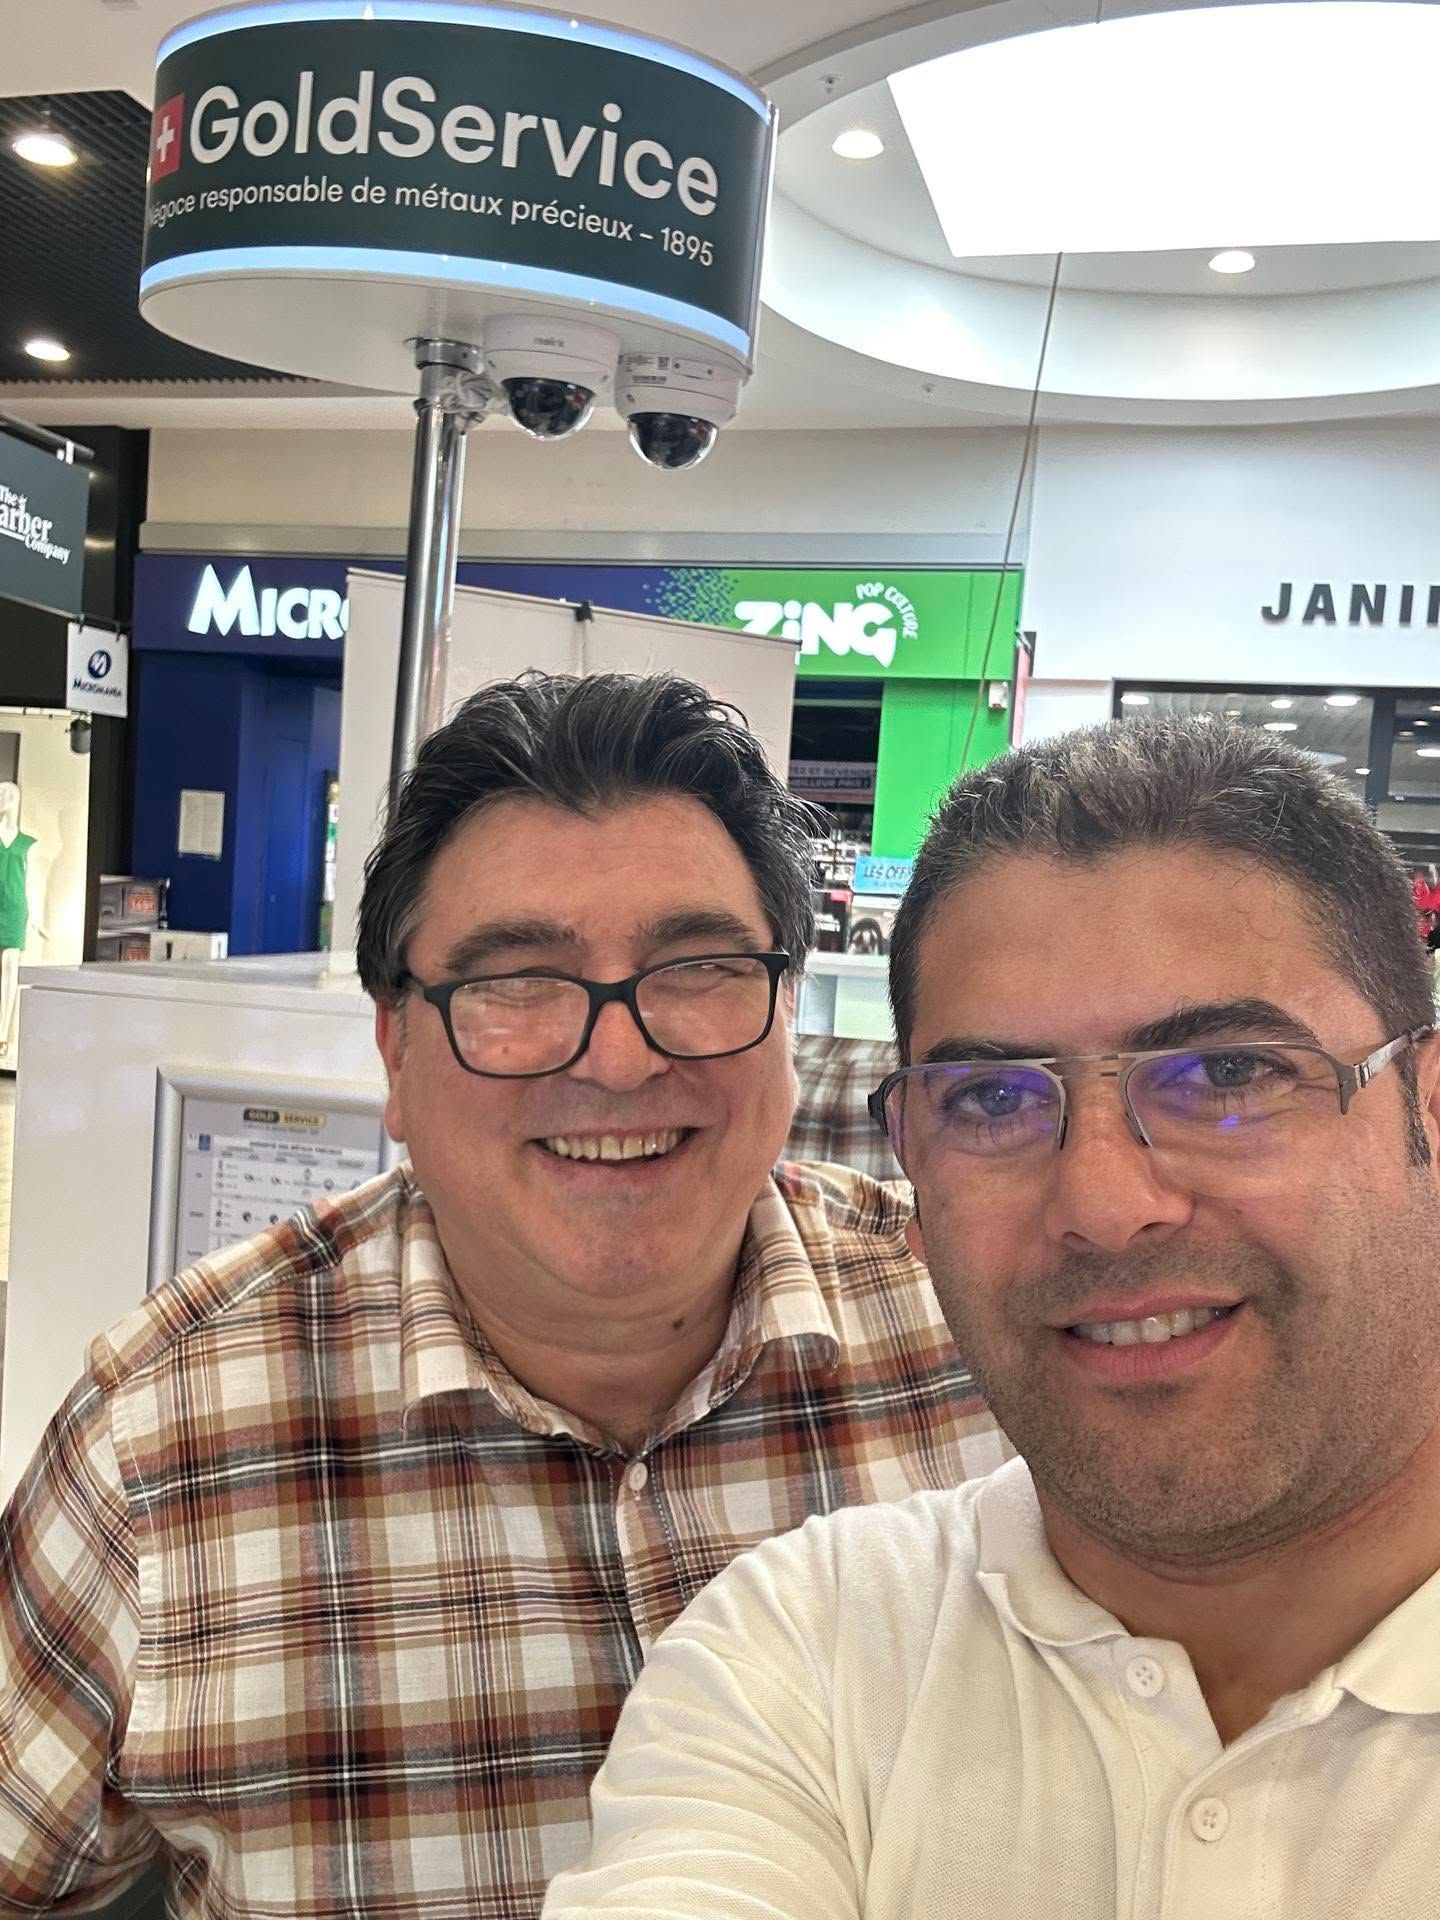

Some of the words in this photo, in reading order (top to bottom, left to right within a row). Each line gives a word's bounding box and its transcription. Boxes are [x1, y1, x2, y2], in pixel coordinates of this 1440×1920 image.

[190, 71, 719, 215] GoldService
[151, 195, 196, 229] égoce
[200, 176, 344, 212] responsable
[351, 176, 387, 204] de
[395, 183, 503, 215] métaux
[511, 199, 633, 241] précieux
[660, 227, 714, 266] 1895
[0, 502, 53, 544] arber
[25, 533, 71, 565] Company
[855, 582, 885, 600] POP
[884, 586, 919, 640] CULTURE
